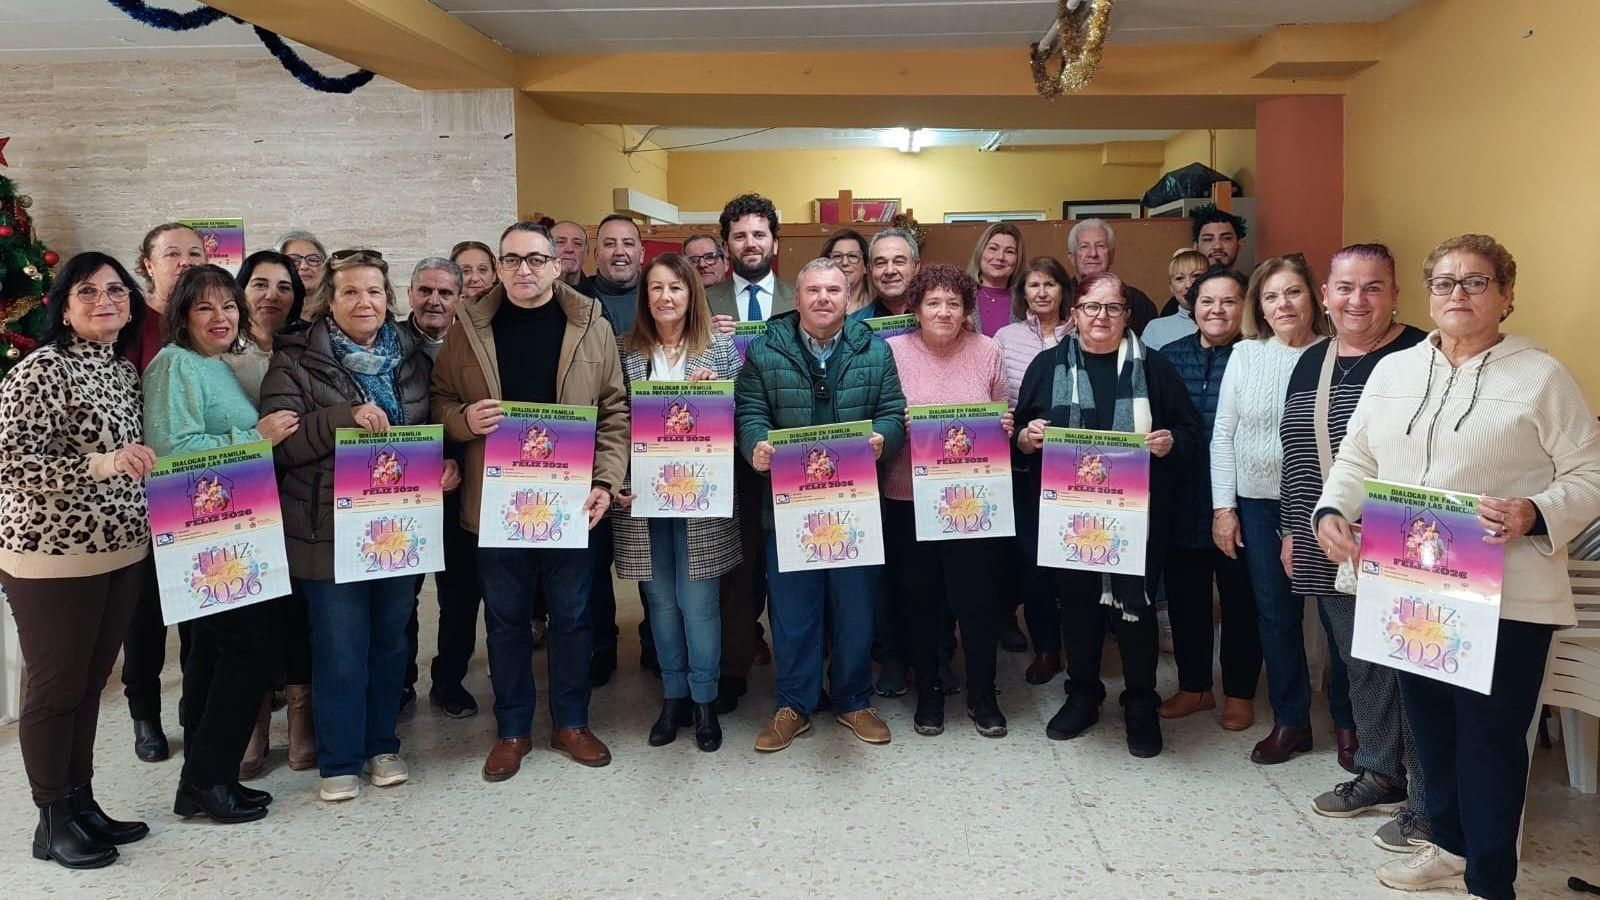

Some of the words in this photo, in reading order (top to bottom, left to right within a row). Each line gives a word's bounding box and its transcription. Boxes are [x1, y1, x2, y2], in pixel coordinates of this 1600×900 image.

[656, 435, 685, 443] FELIZ
[150, 469, 170, 478] PARA
[171, 462, 207, 475] PREVENIR
[207, 459, 221, 468] LAS
[172, 456, 207, 468] DIALOGAR
[207, 454, 219, 462] EN
[219, 449, 247, 460] FAMILIA
[936, 457, 964, 465] FELIZ
[362, 487, 393, 496] FELIZ
[392, 485, 420, 494] 2026
[798, 483, 828, 492] FELIZ
[828, 479, 855, 489] 2026
[1068, 485, 1097, 493] FELIZ
[1096, 486, 1124, 495] 2026
[658, 491, 710, 512] 2026
[1368, 492, 1388, 502] PARA
[1389, 494, 1426, 507] PREVENIR
[1427, 501, 1443, 510] LAS
[1391, 488, 1427, 501] DIALOGAR
[1429, 495, 1440, 503] EN
[1441, 496, 1474, 508] FAIA
[185, 513, 220, 528] FELIZ
[221, 508, 253, 521] 2026
[942, 513, 992, 533] 2026
[507, 521, 562, 541] 2026
[365, 547, 420, 573] 2026
[804, 540, 859, 563] 2026
[1065, 542, 1121, 567] 2026
[1432, 564, 1468, 580] 2026
[196, 573, 263, 609] 2026
[1388, 632, 1460, 675] 2026
